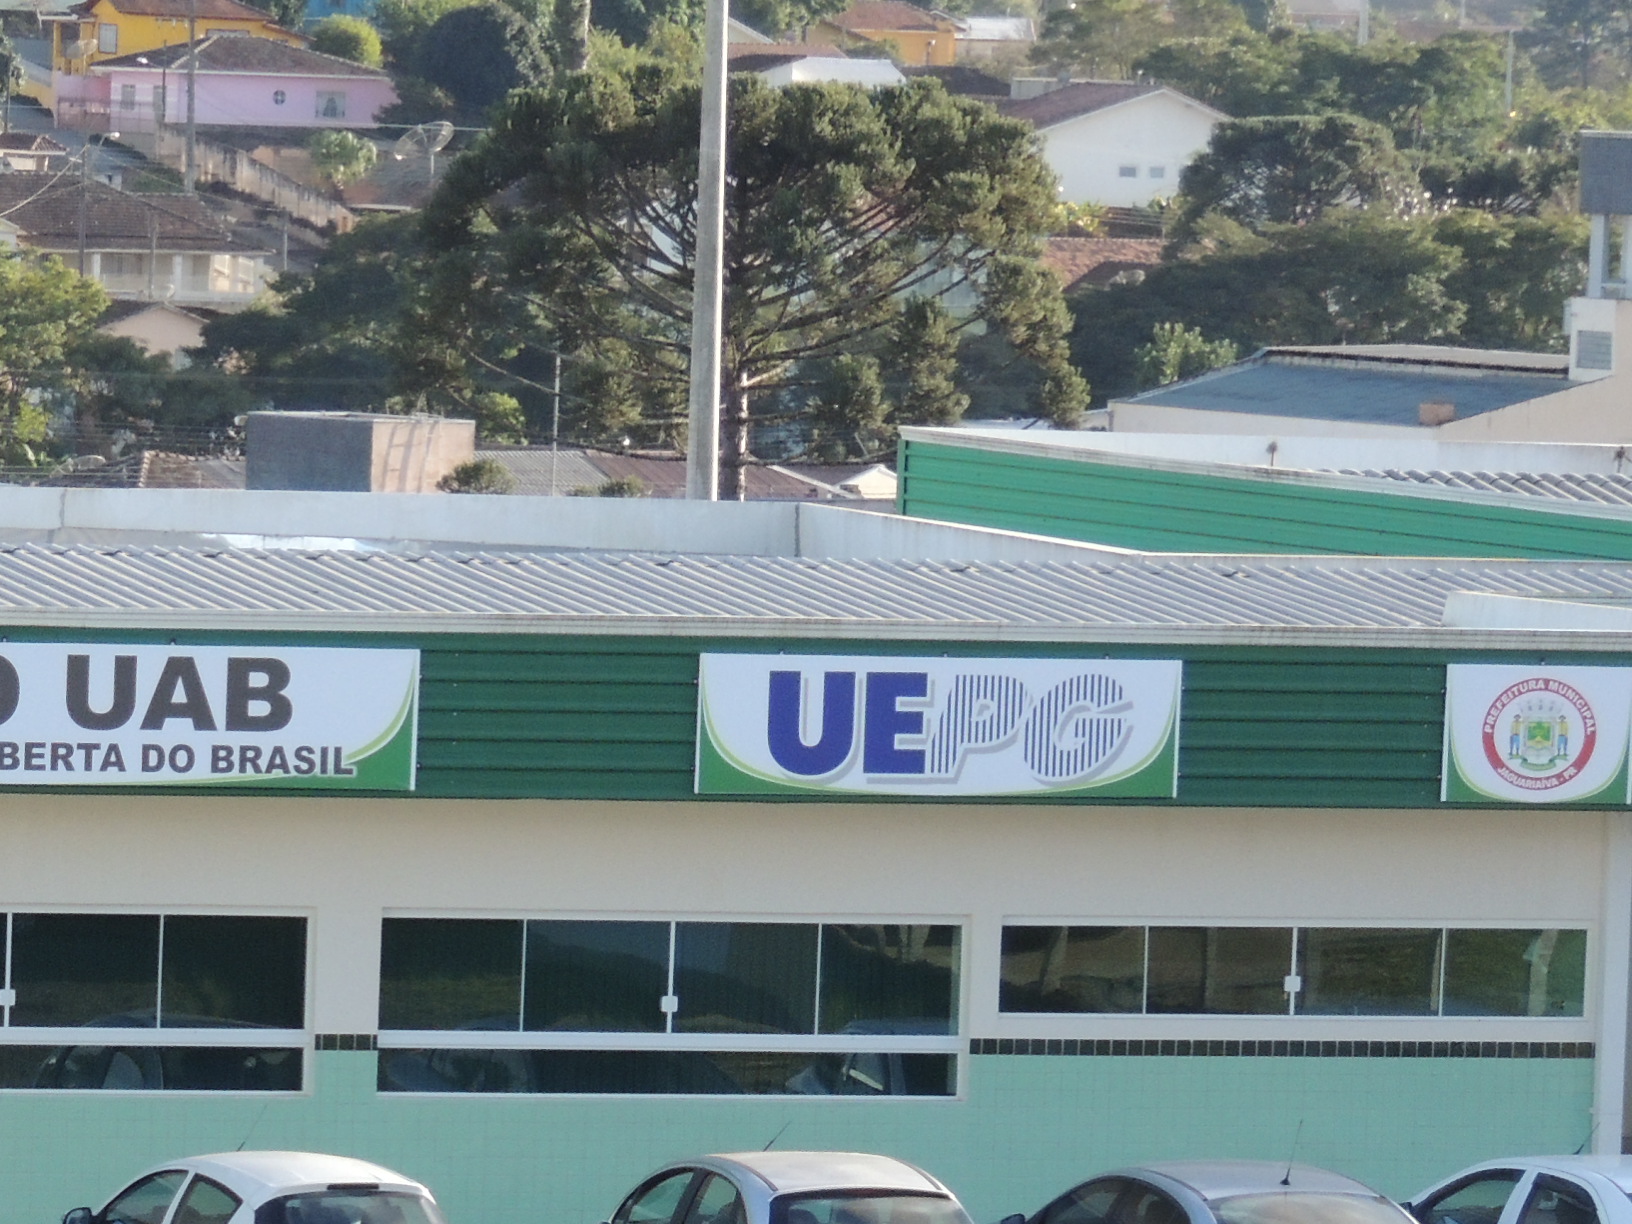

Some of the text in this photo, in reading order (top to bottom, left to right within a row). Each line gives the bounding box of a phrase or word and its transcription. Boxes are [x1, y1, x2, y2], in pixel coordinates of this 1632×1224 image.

[65, 656, 294, 732] UAB
[768, 670, 1133, 783] UEPG
[1484, 679, 1596, 735] PREFEITURA MUNICIPAL
[141, 744, 195, 774] DO
[211, 745, 354, 776] BRASIL
